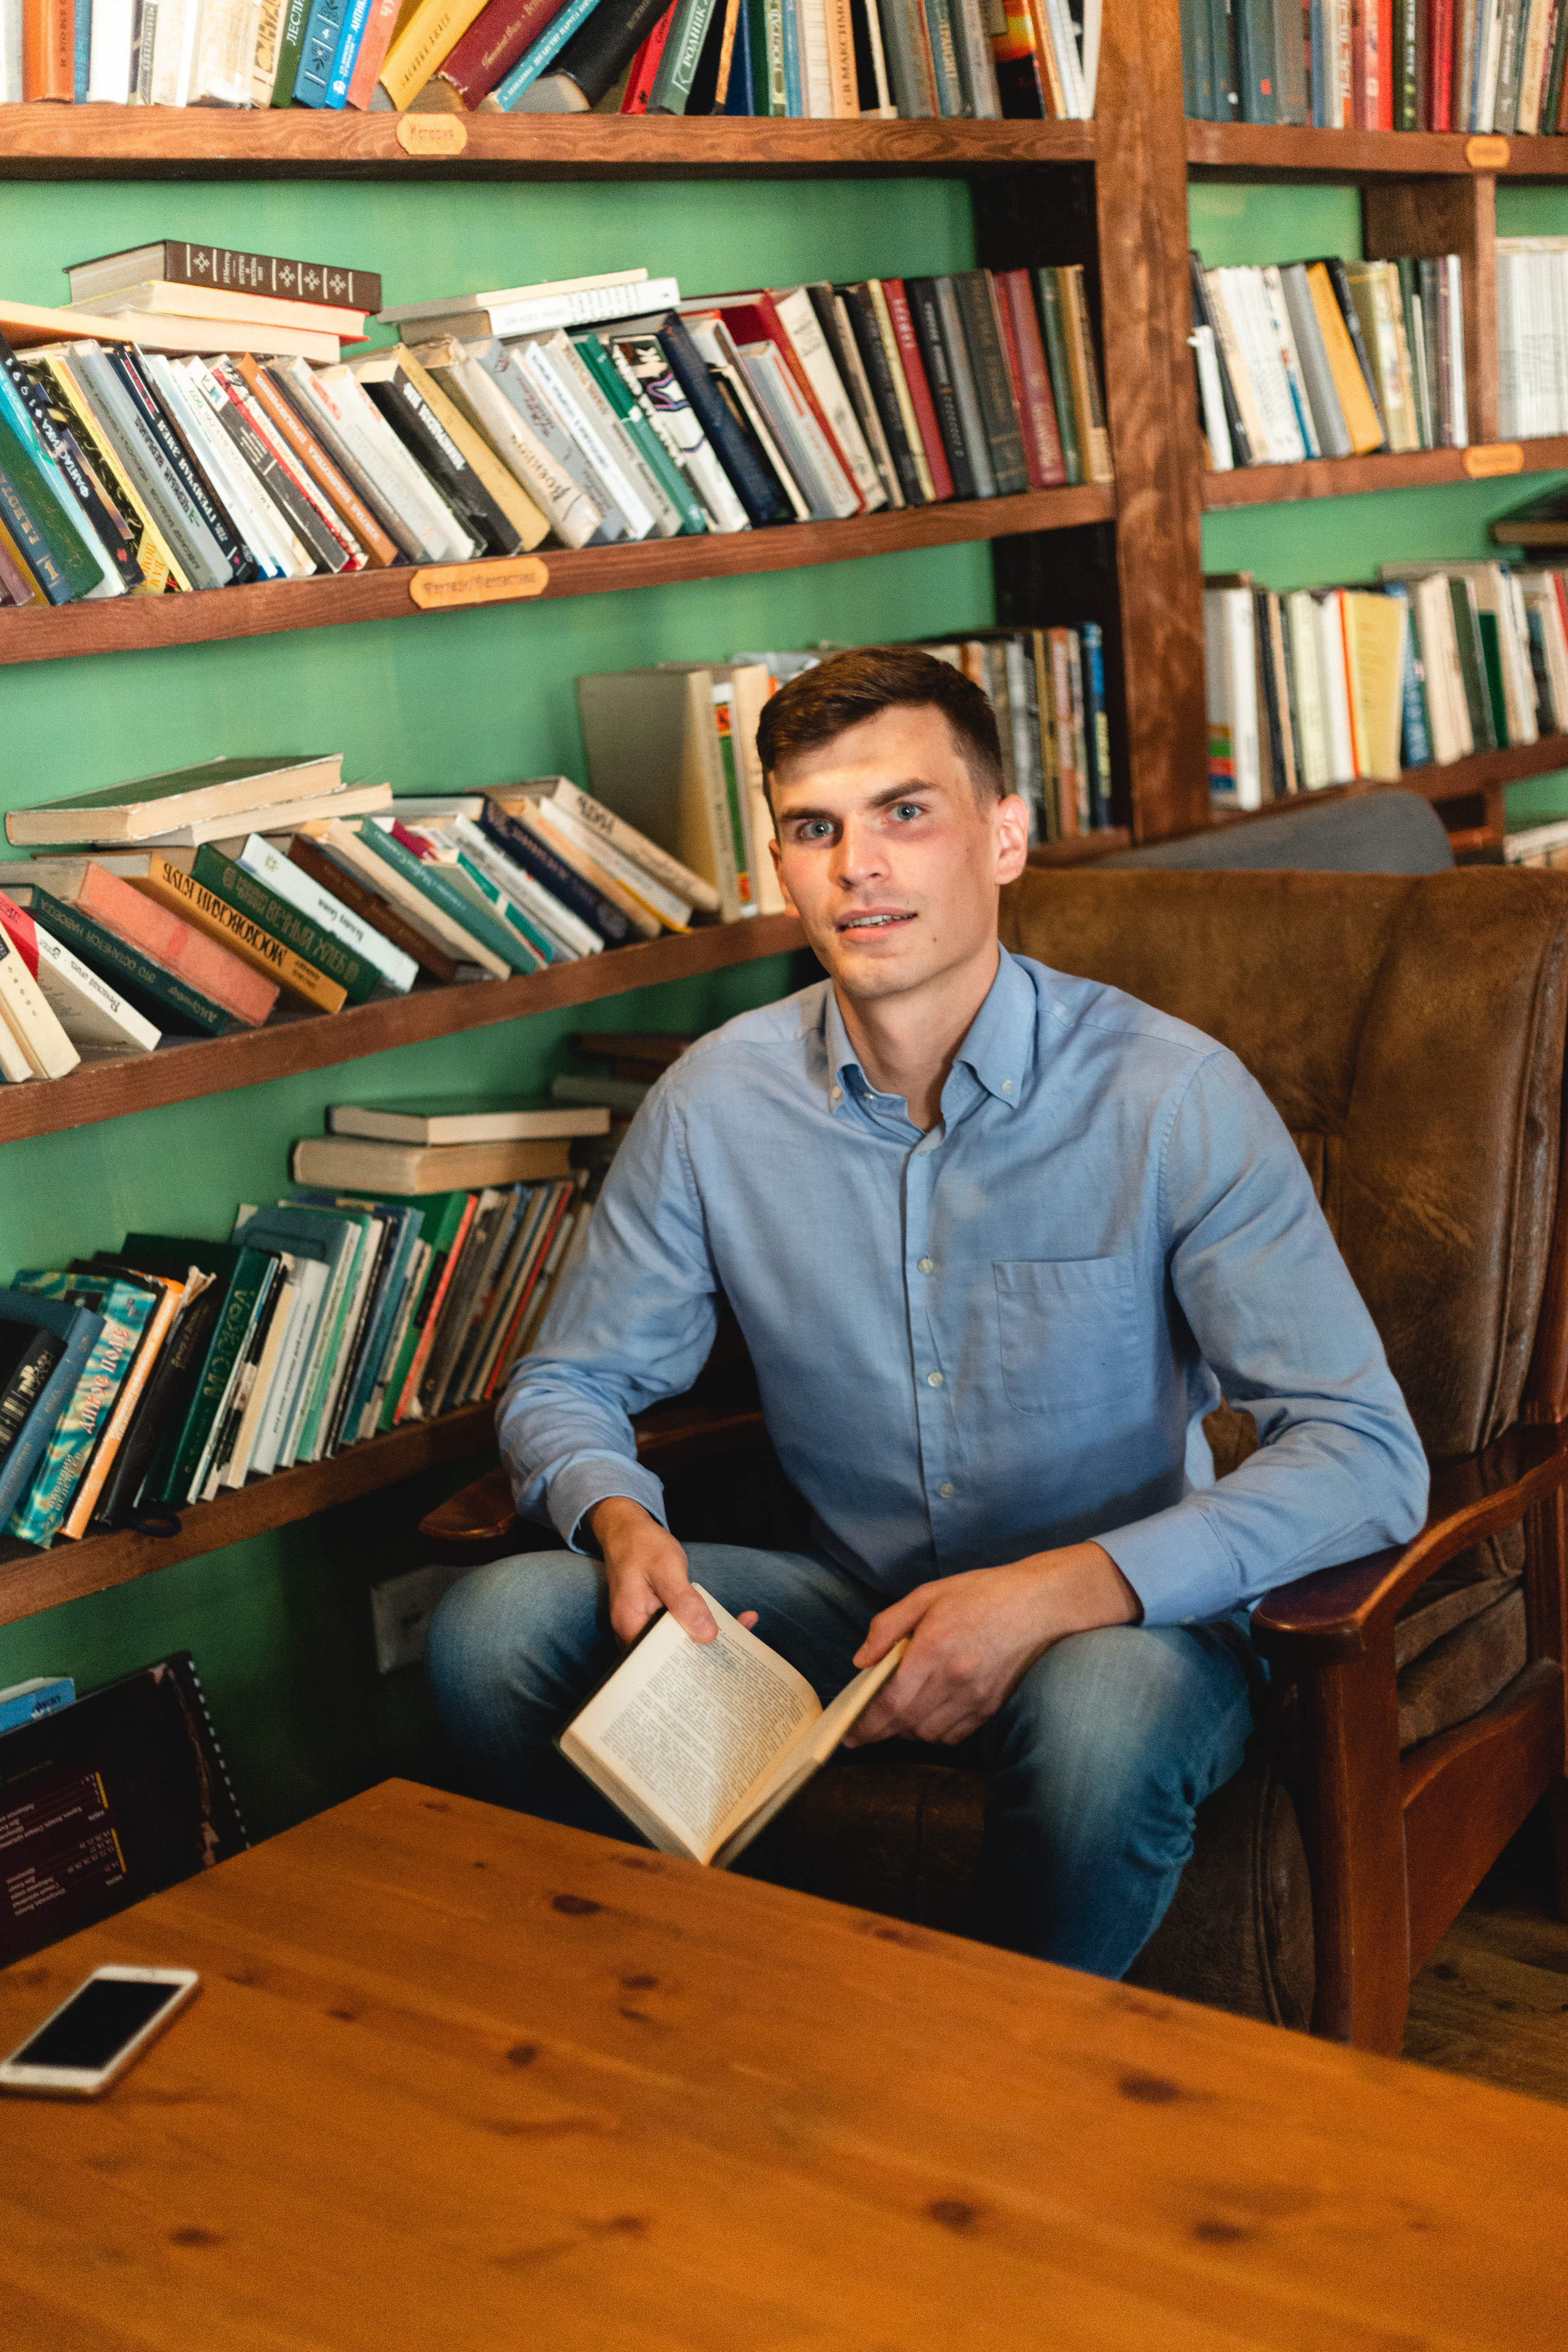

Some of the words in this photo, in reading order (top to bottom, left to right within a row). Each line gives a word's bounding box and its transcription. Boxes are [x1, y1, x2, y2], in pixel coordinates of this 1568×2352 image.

[322, 28, 331, 40] 4
[680, 4, 707, 67] РОДНИК
[835, 0, 850, 80] МАКСИМО
[187, 386, 205, 409] 007
[39, 417, 91, 498] ФАНТАСТИКА
[129, 413, 167, 469] ВЕРБЛЮД
[155, 418, 183, 458] ЗМЕЯ
[177, 456, 219, 523] ГРЕМУЧАЯ
[304, 443, 353, 504] БИБЛИОТЕКА
[156, 862, 198, 898] КЛУБ
[36, 897, 86, 935] НАВСЕГДА
[190, 889, 292, 968] МОСКОВСКИЙ
[84, 929, 138, 971] ОСТАНЕТСЯ
[135, 964, 157, 984] ЭТО
[307, 937, 352, 975] ХЛЕБ
[77, 1371, 111, 1435] ДИКОЕ
[99, 1324, 131, 1374] ПОЛЕ
